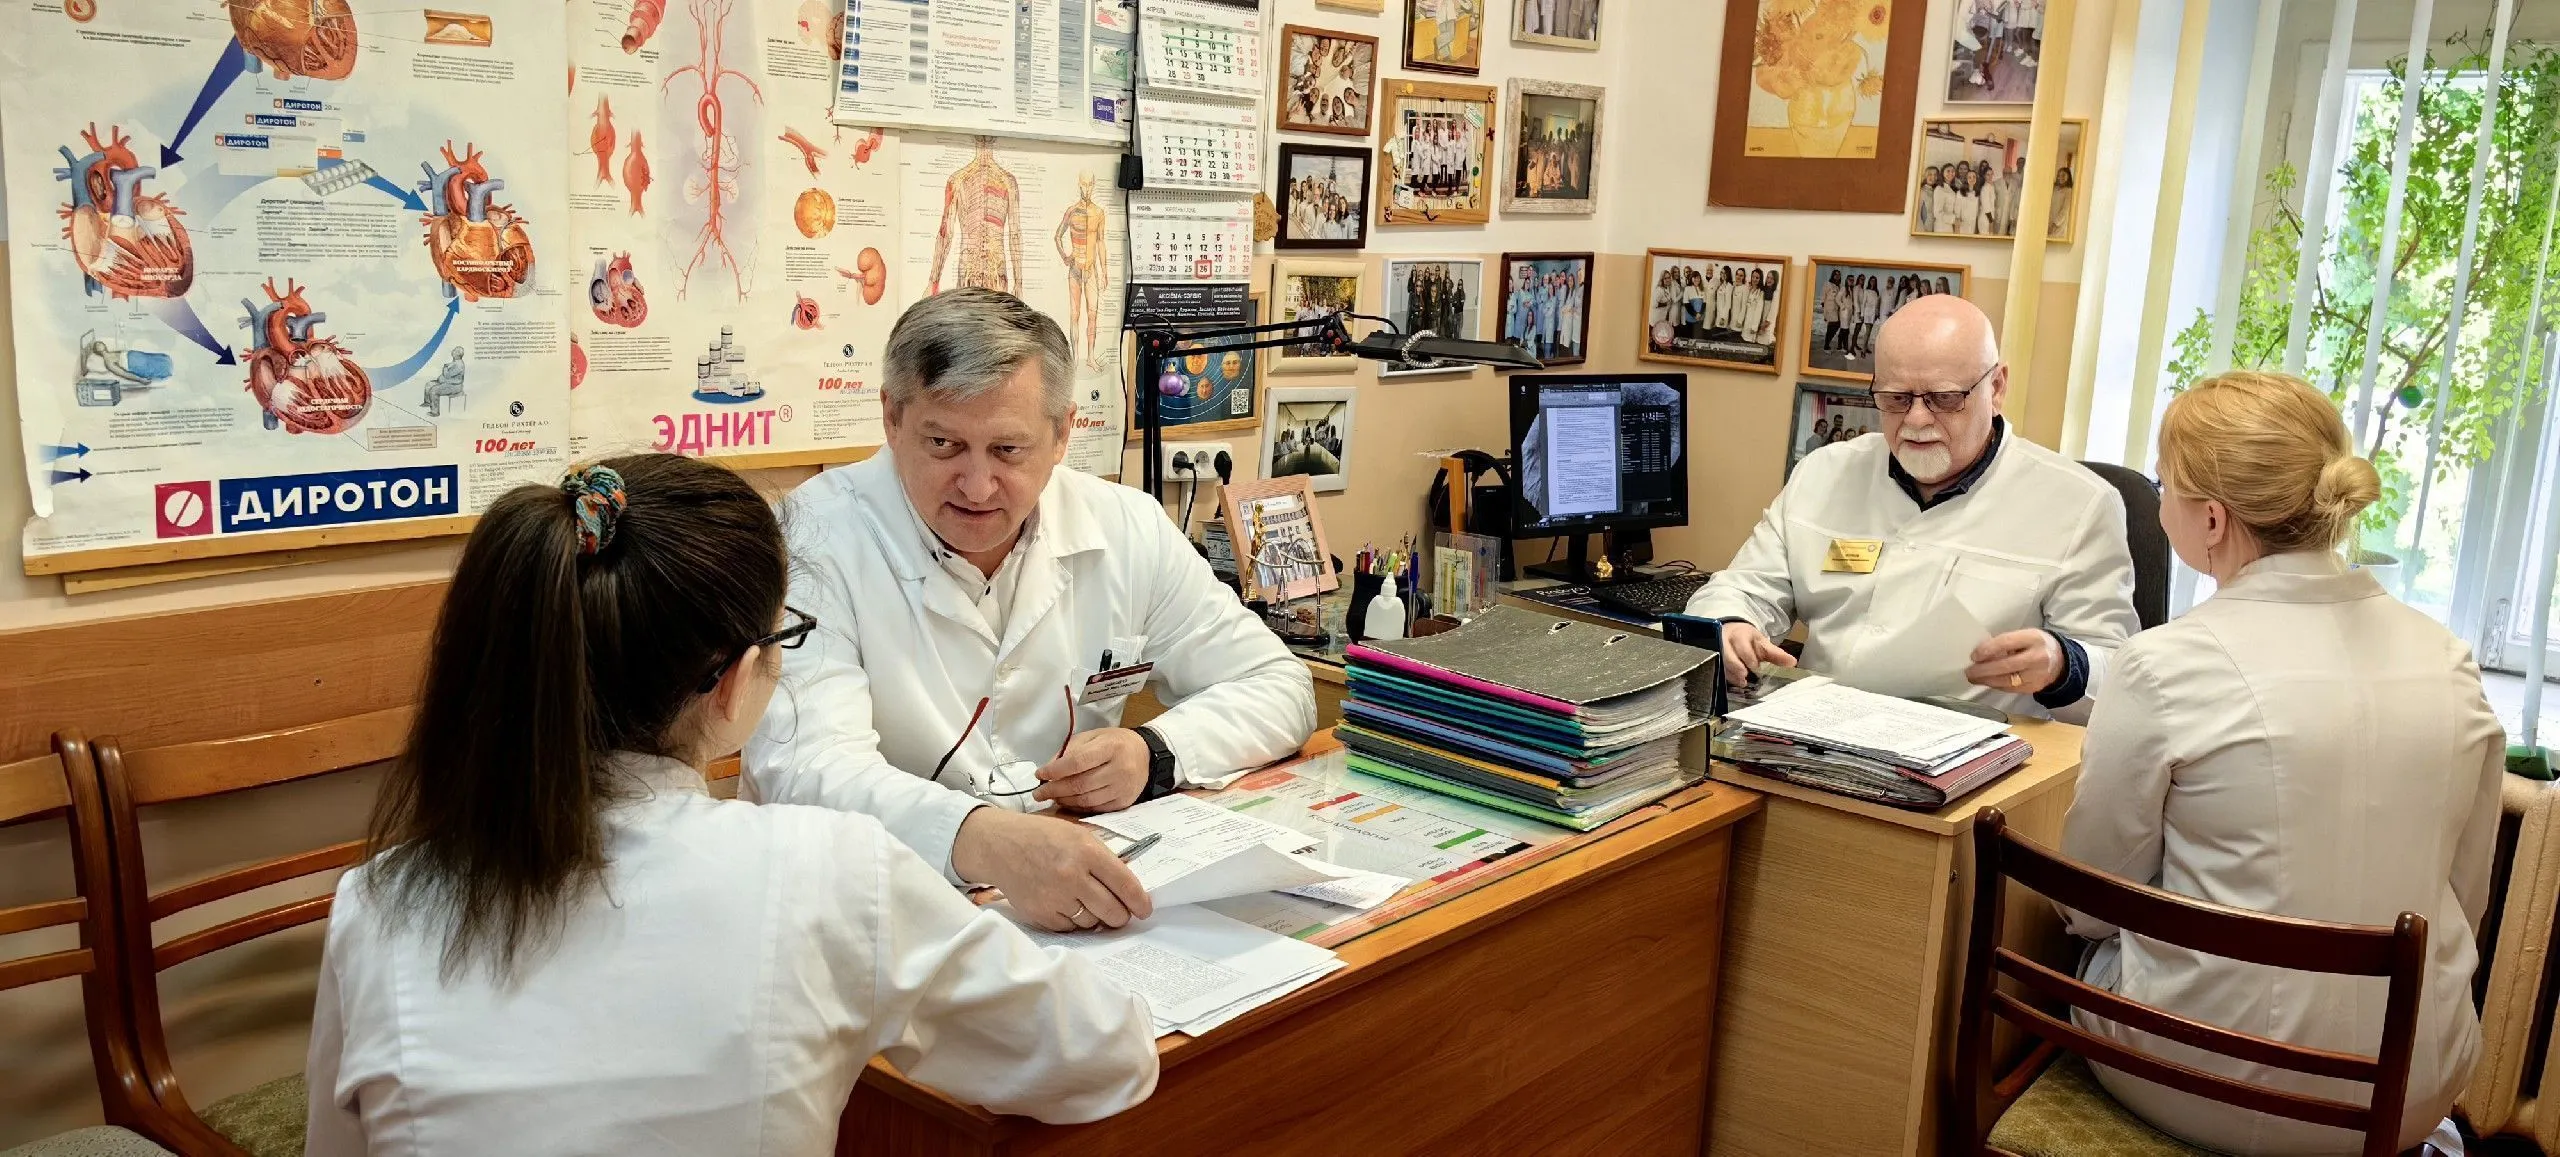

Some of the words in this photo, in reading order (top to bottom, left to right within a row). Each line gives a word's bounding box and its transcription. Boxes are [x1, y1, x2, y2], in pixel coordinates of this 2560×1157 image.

[1196, 40, 1199, 48] 9
[1180, 50, 1187, 58] 15
[1195, 52, 1202, 60] 16
[1250, 59, 1257, 67] 20
[1181, 61, 1189, 69] 22
[1224, 66, 1231, 74] 25
[1168, 70, 1176, 78] 28
[1197, 73, 1205, 81] 30
[285, 100, 322, 111] ДИРОТОН
[256, 116, 296, 126] ДИРОТОН
[226, 139, 267, 148] ДИРОТОН
[1207, 150, 1214, 158] 15
[1179, 159, 1187, 167] 20
[1209, 171, 1217, 179] 29
[1156, 232, 1160, 240] 2
[1156, 243, 1160, 251] 9
[1200, 244, 1207, 252] 12
[1154, 254, 1162, 262] 16
[1169, 254, 1177, 262] 17
[818, 377, 843, 390] 100
[844, 381, 863, 389] лет
[475, 438, 508, 454] 100
[510, 441, 536, 452] лет
[231, 477, 449, 525] ДИРОТОН
